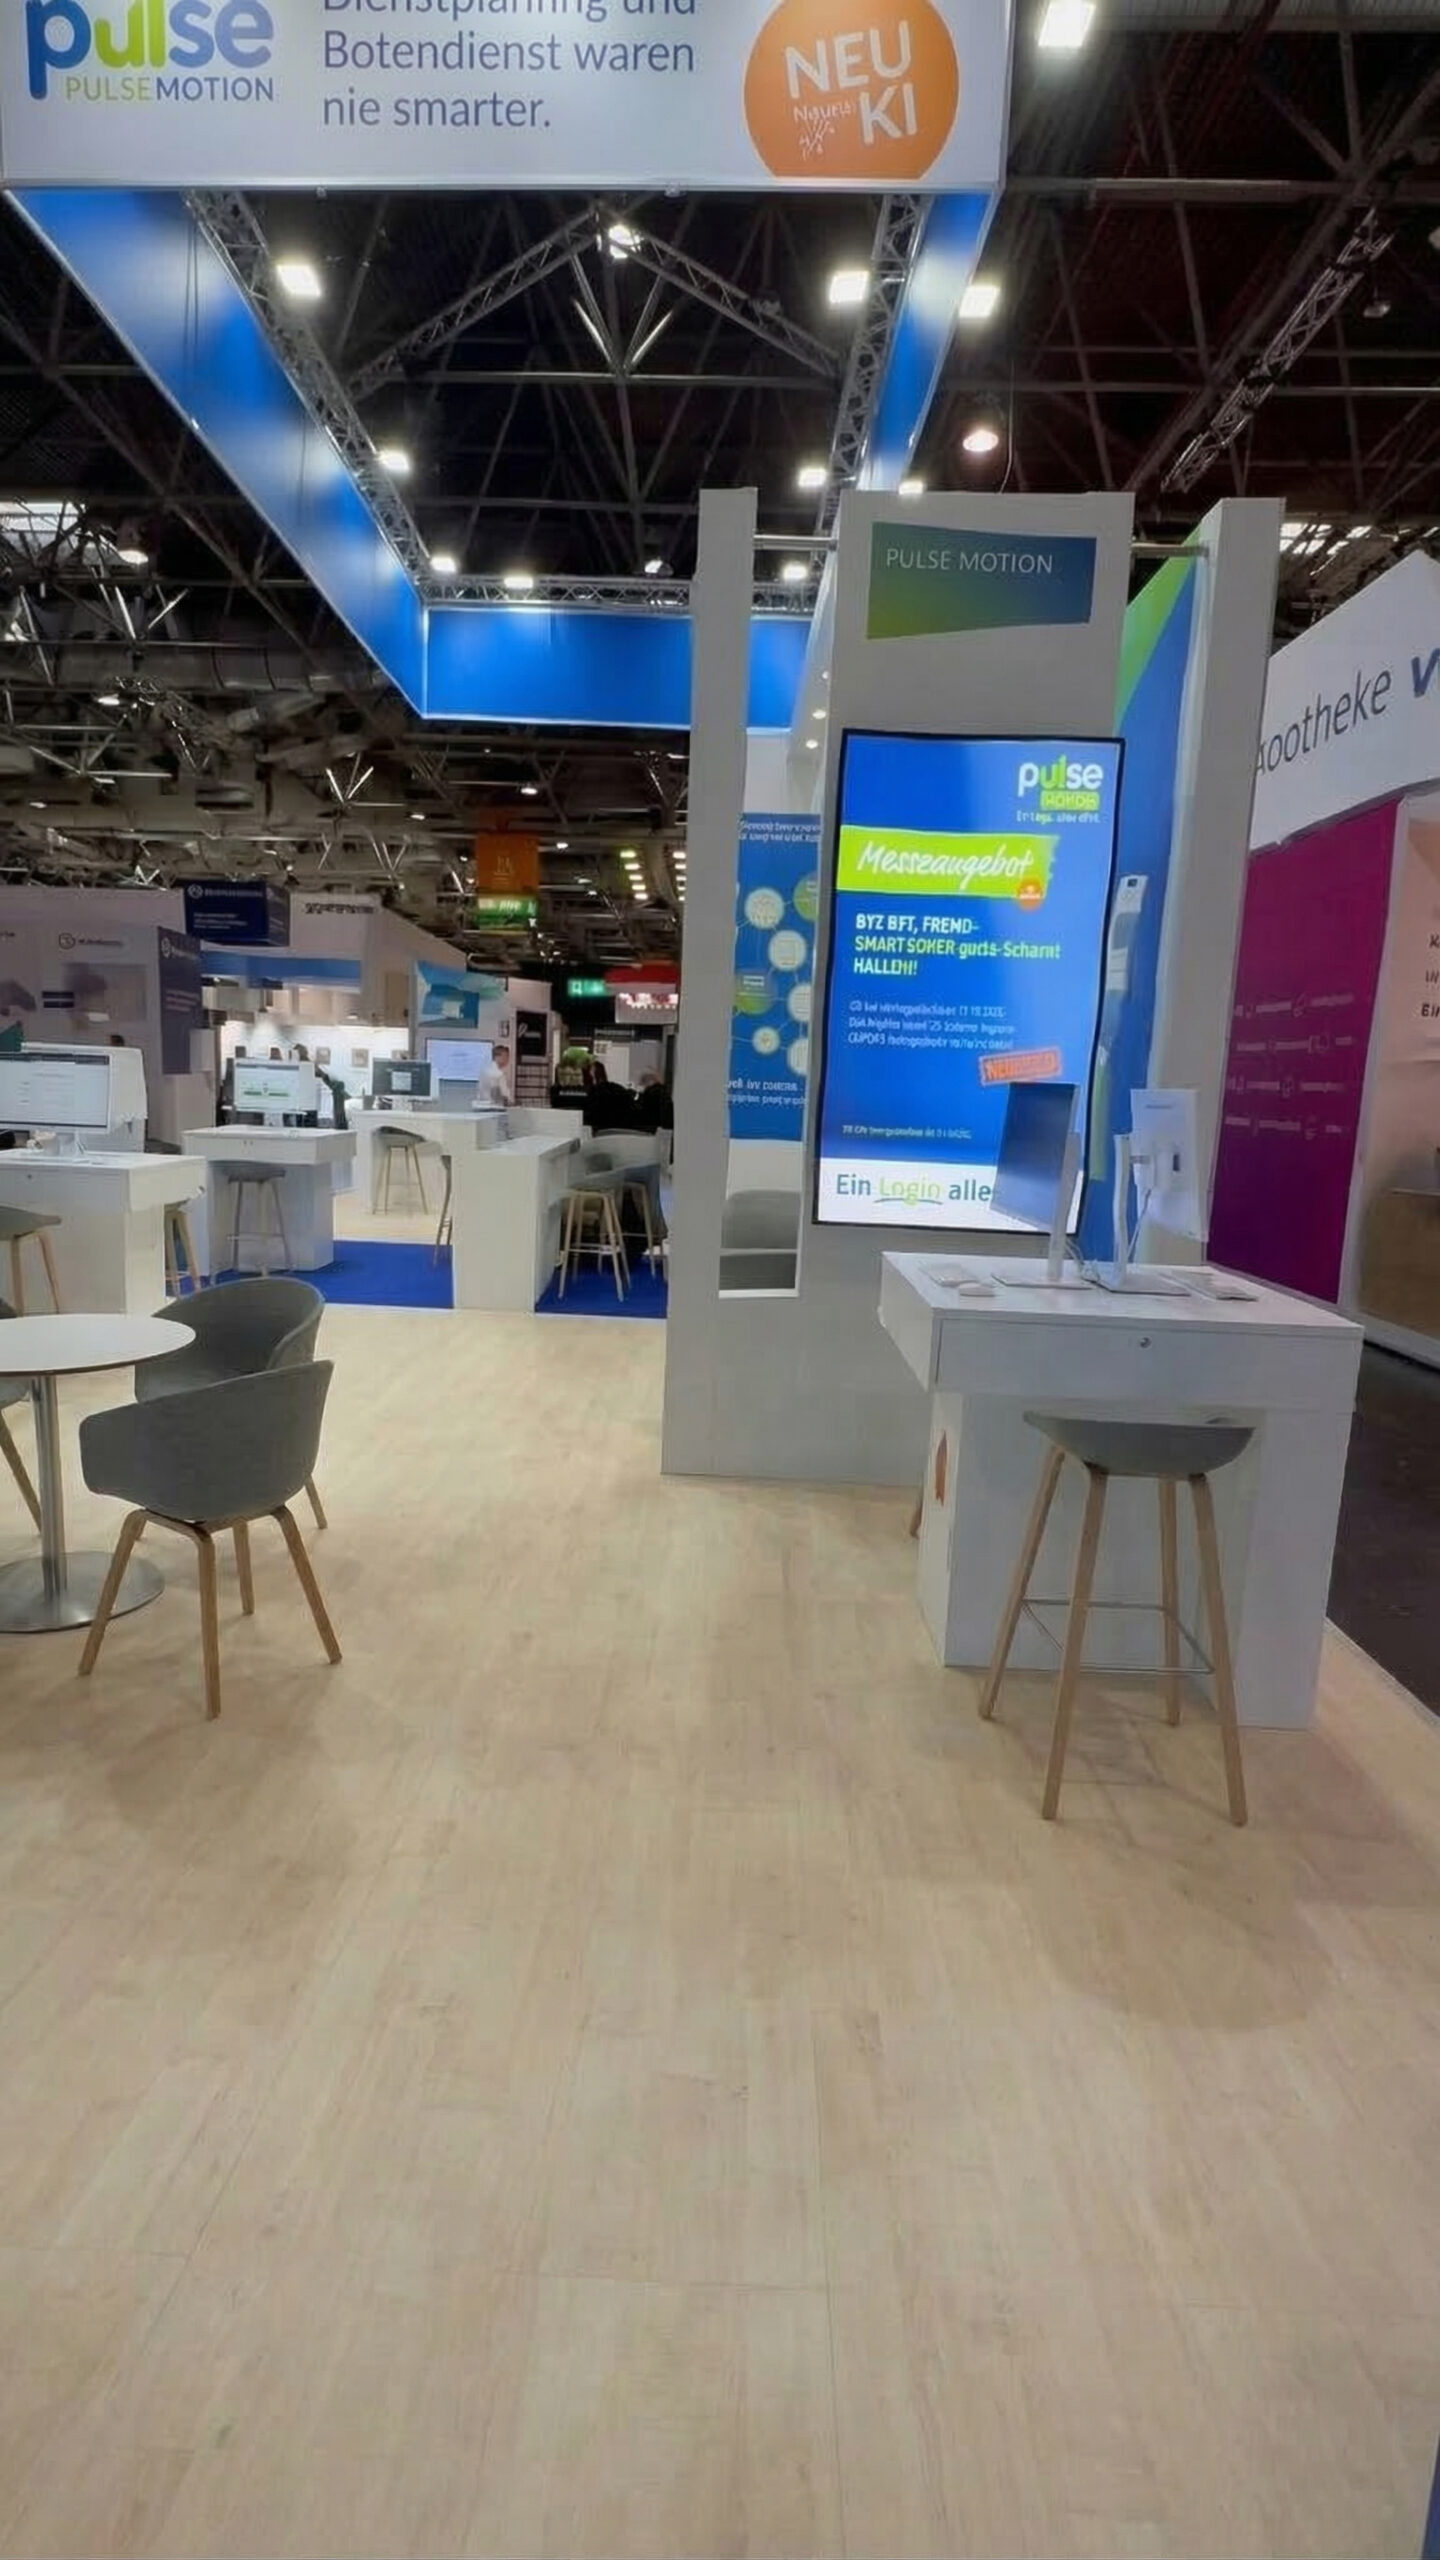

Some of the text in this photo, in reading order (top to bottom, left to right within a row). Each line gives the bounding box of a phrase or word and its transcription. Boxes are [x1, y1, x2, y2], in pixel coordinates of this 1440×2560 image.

[26, 0, 274, 100] pulse
[324, 30, 694, 72] Botendienst waren
[785, 20, 912, 99] NEU
[323, 88, 550, 128] nie smarter.
[859, 82, 917, 145] KI
[886, 548, 1053, 574] PULSE MOTION
[1018, 754, 1103, 798] pulse
[836, 1173, 992, 1206] Ein Login alle
